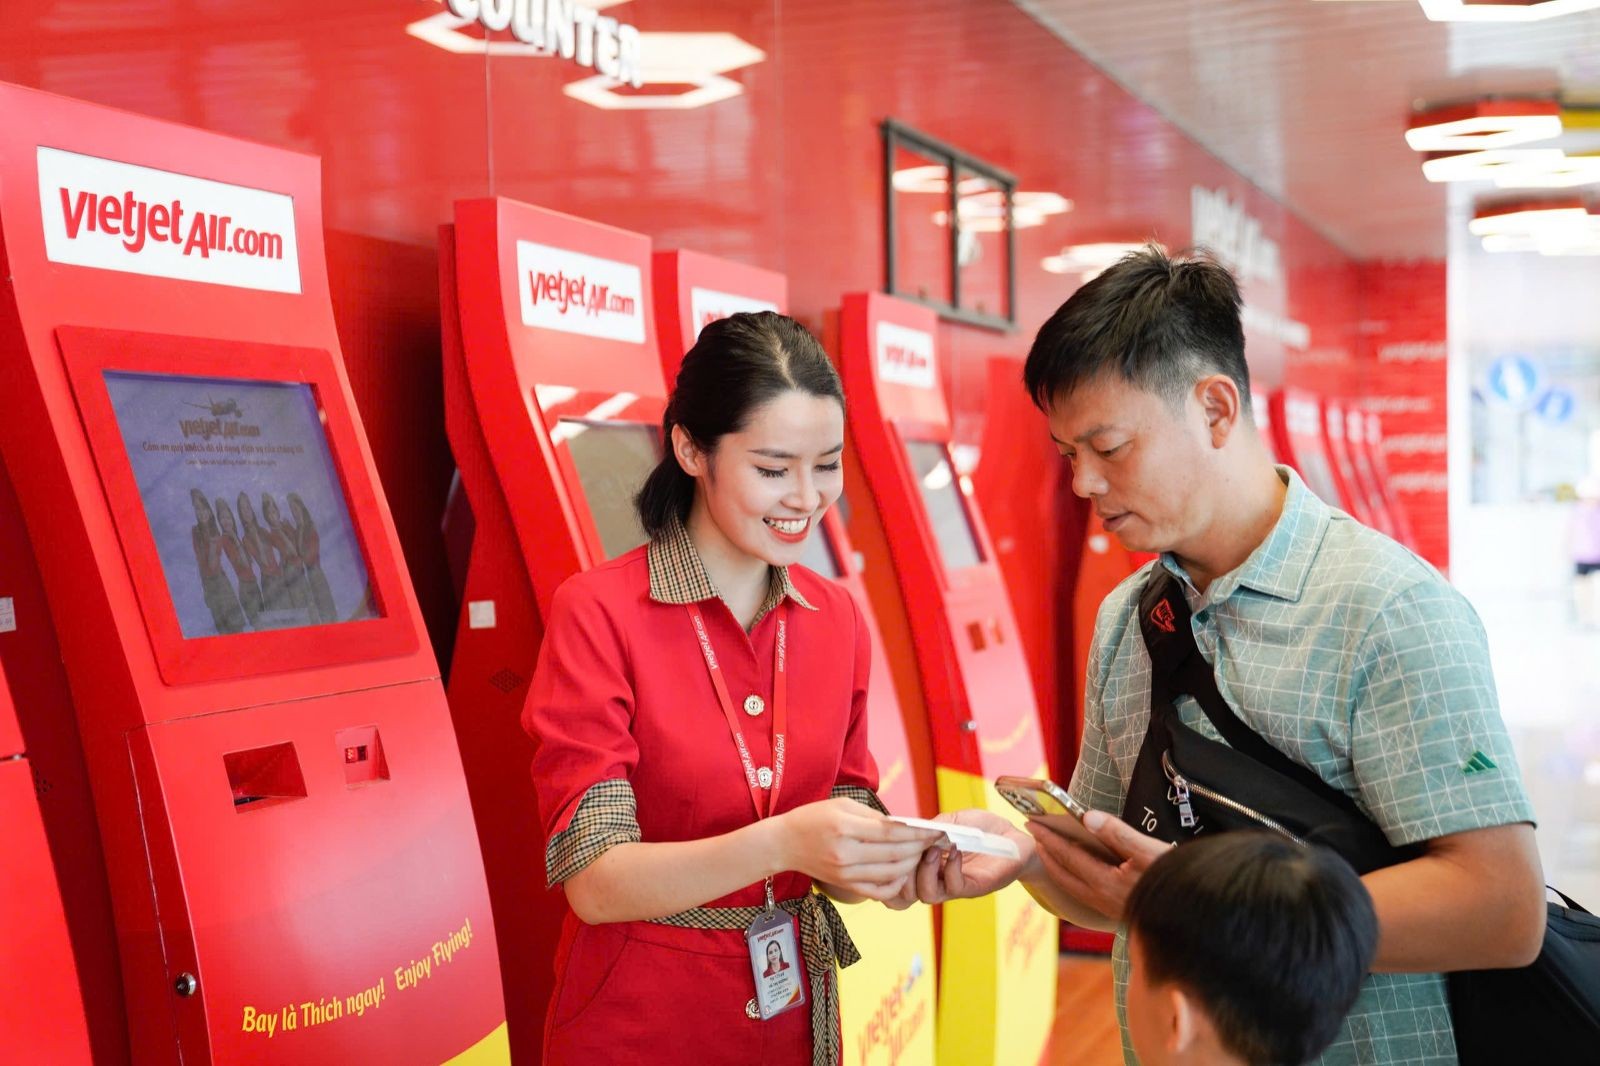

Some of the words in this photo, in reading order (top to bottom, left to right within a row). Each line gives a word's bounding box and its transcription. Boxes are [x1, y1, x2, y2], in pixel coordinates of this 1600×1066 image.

[242, 1006, 277, 1038] Bay
[282, 1004, 297, 1031] là
[300, 996, 342, 1027] Thích
[346, 977, 386, 1017] ngay!
[394, 956, 431, 990] Enjoy
[431, 917, 473, 967] Flying!
